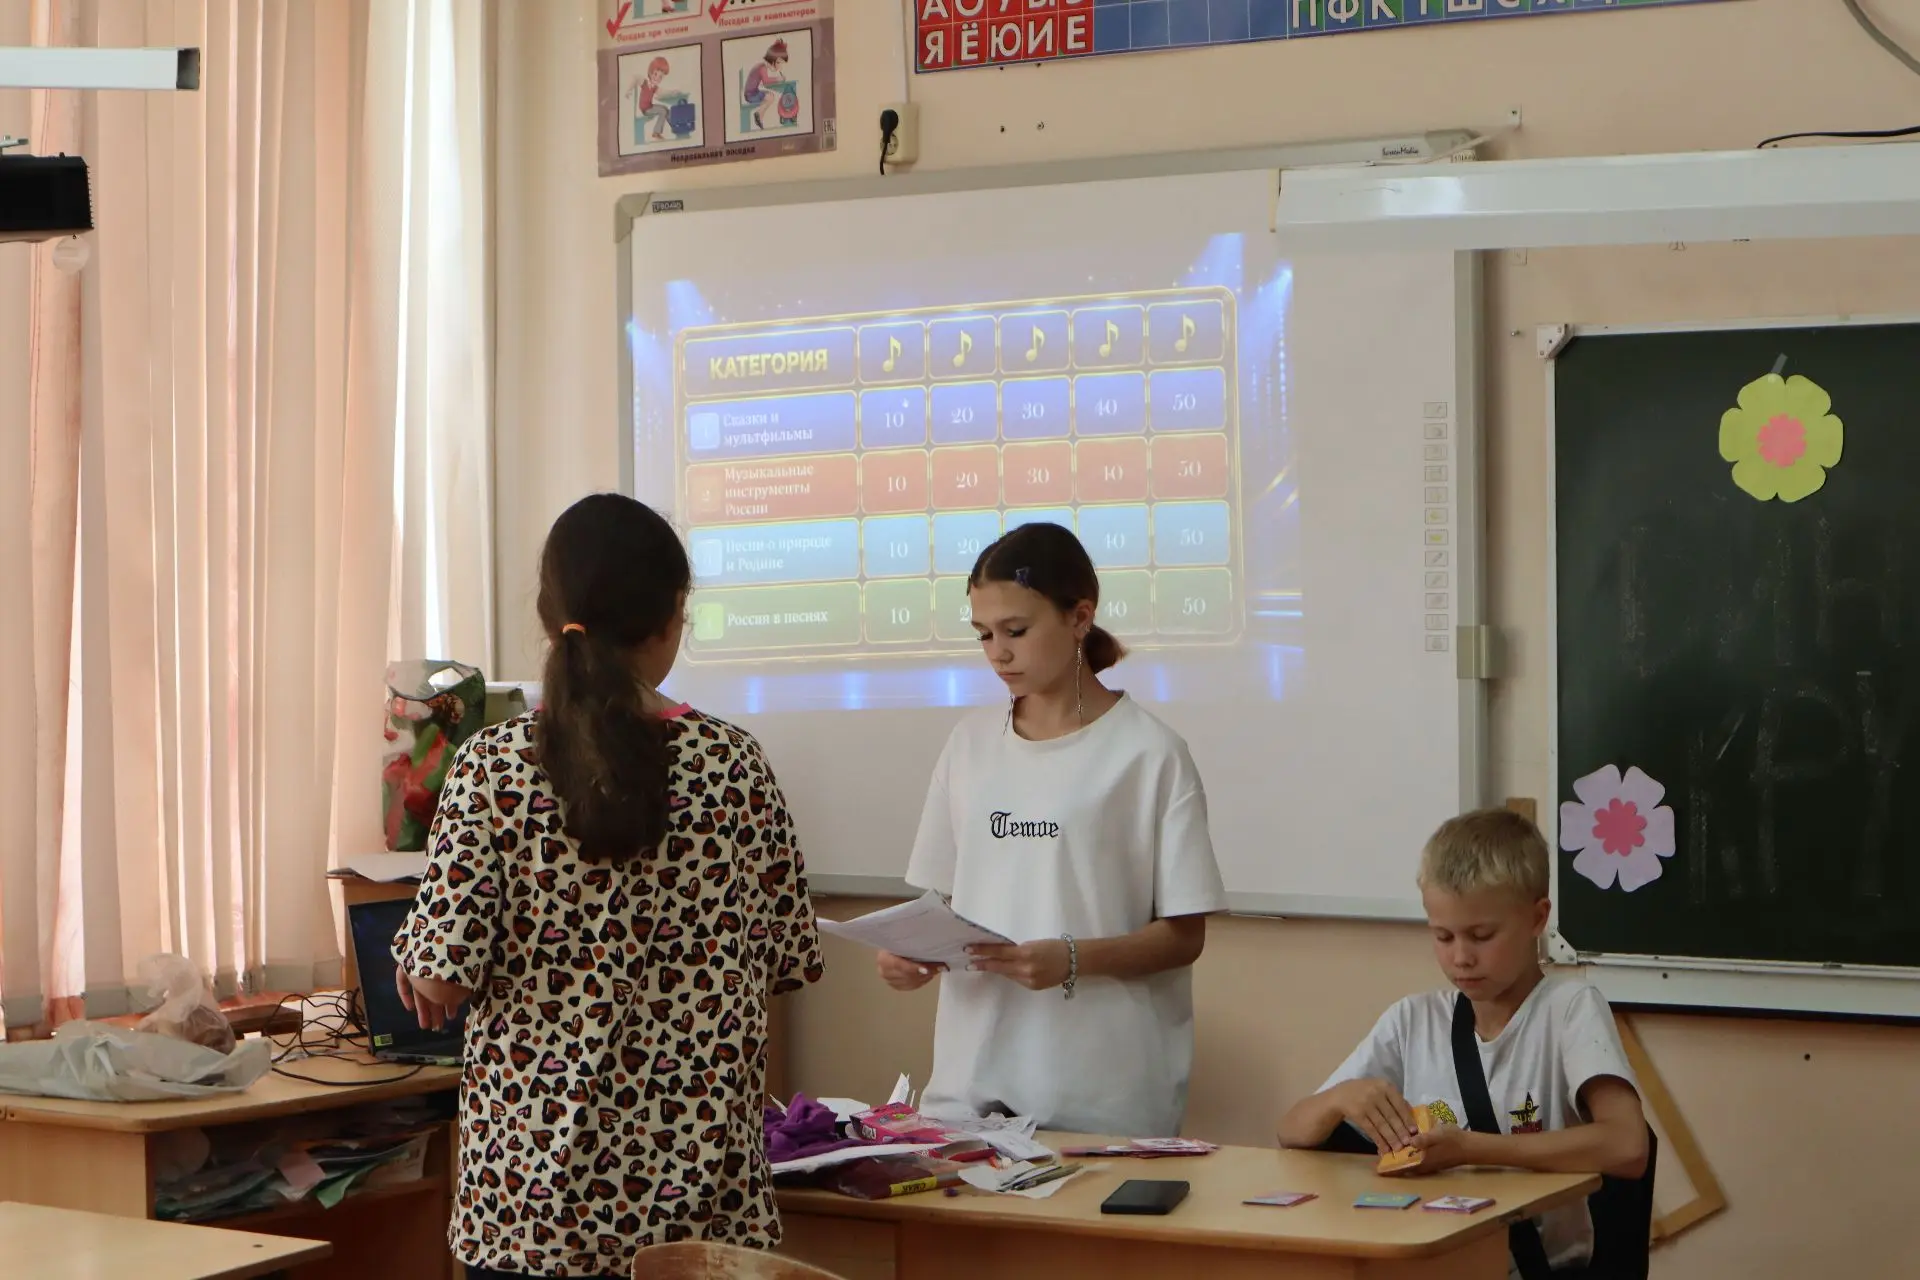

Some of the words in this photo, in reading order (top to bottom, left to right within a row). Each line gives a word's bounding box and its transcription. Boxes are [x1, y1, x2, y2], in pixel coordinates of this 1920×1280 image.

[709, 348, 828, 379] КАТЕГОРИЯ
[1022, 402, 1045, 420] 30
[1094, 398, 1118, 417] 40
[1172, 393, 1197, 411] 50
[723, 412, 767, 427] Сказки
[770, 412, 779, 424] и
[884, 411, 905, 429] 10
[951, 406, 974, 424] 20
[723, 428, 813, 448] мультфильмы
[724, 465, 815, 484] Музыкальные
[1026, 467, 1050, 485] 30
[1178, 459, 1202, 478] 50
[887, 474, 907, 493] 10
[955, 470, 979, 489] 20
[725, 482, 811, 501] инструменты
[725, 503, 769, 516] России
[726, 538, 764, 553] Песни
[779, 535, 833, 553] природе
[957, 537, 980, 555] 20
[1179, 528, 1204, 546] 50
[888, 541, 908, 559] 10
[726, 562, 735, 572] и
[738, 556, 785, 572] Родине
[958, 605, 973, 622] 2
[1104, 600, 1128, 618] 40
[1182, 597, 1206, 616] 50
[727, 612, 770, 627] Россия
[773, 613, 781, 624] в
[784, 610, 829, 625] песнях
[890, 607, 910, 625] 10
